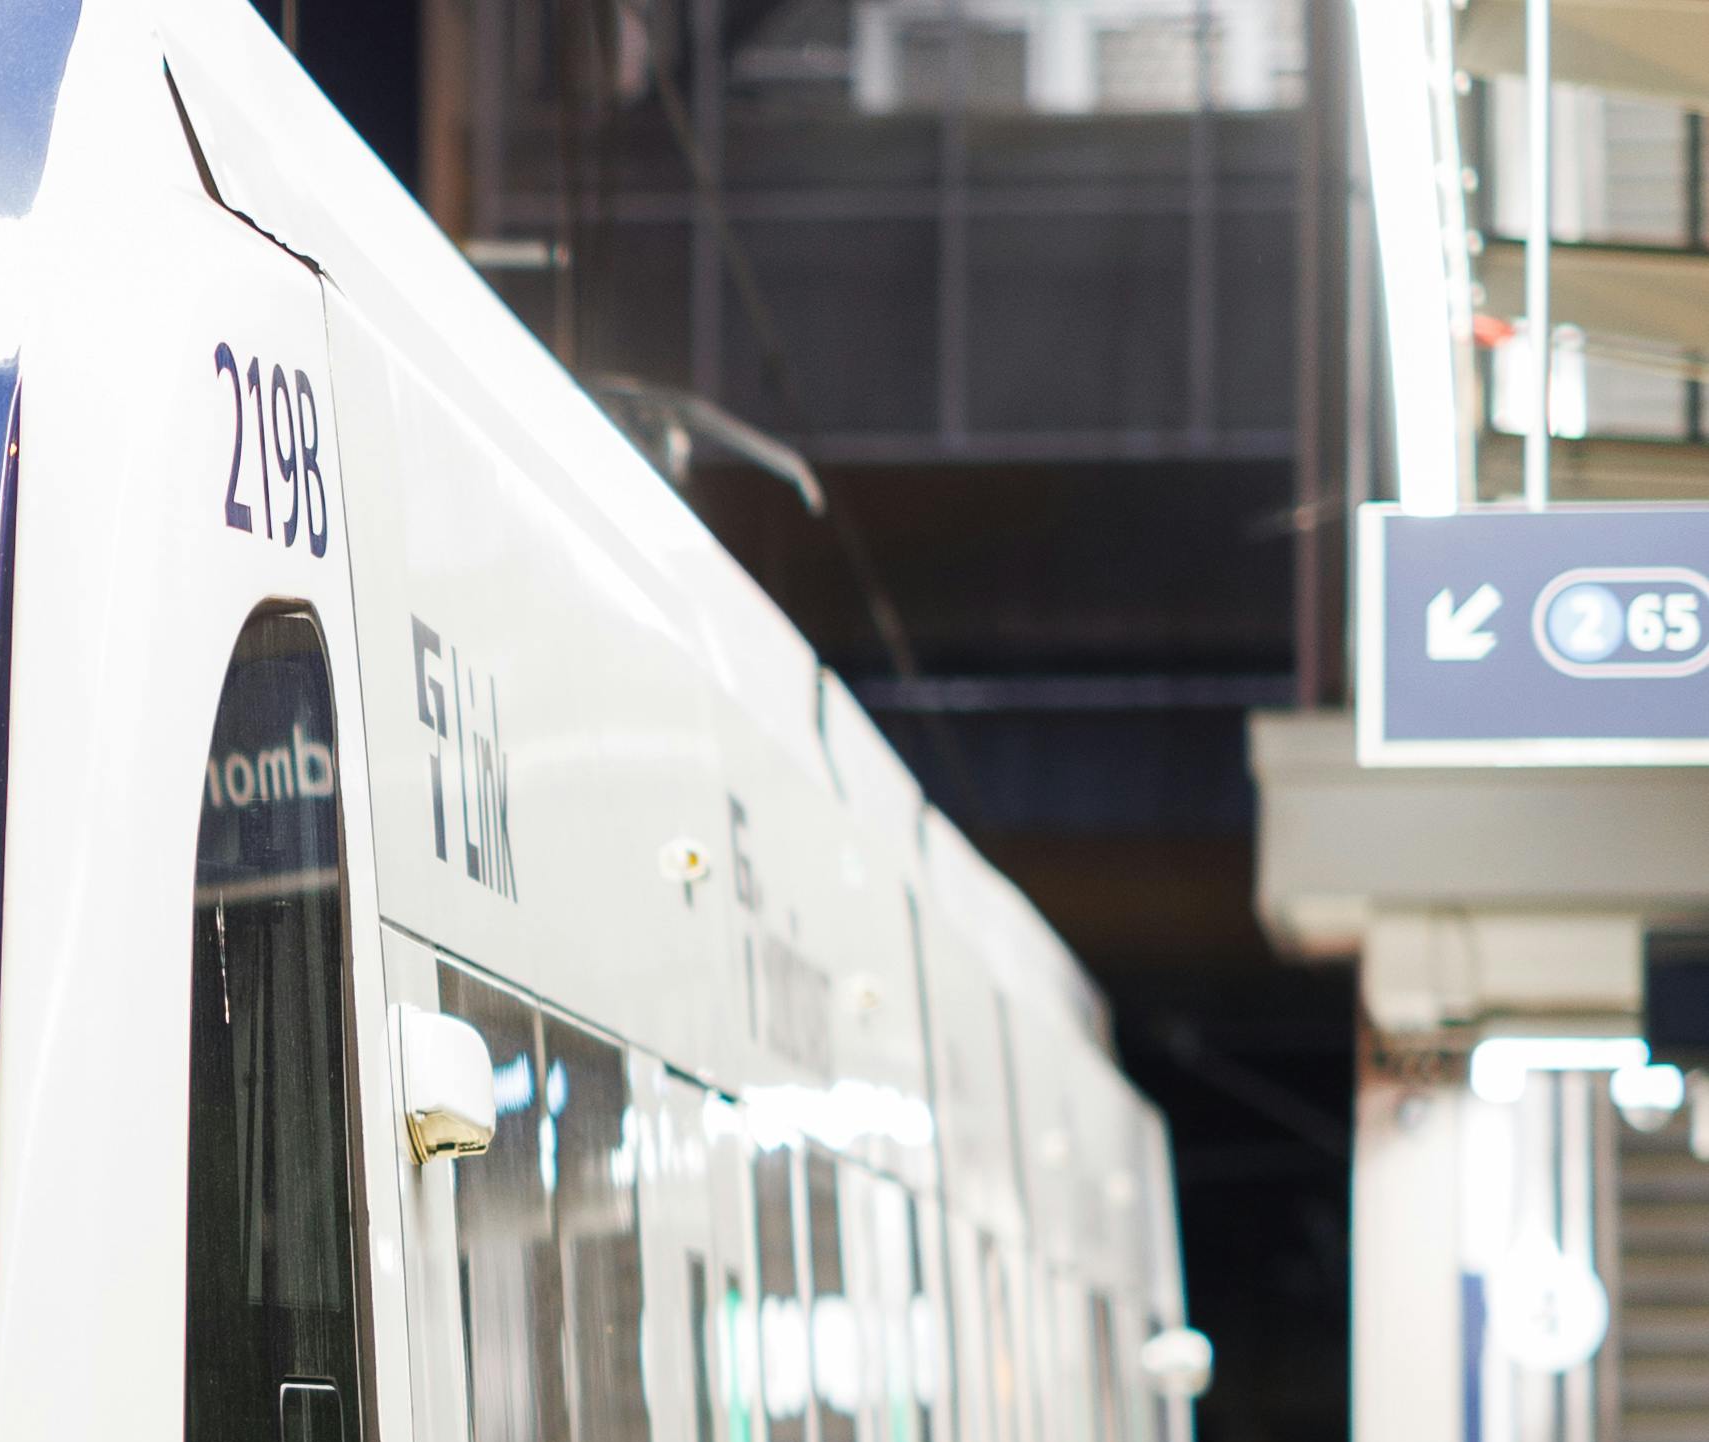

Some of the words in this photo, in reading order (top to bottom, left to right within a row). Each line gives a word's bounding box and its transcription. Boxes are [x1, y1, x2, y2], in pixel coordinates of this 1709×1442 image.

[214, 341, 328, 559] 219B
[1568, 593, 1606, 652] 2
[1626, 592, 1702, 653] 65
[449, 645, 518, 904] Link
